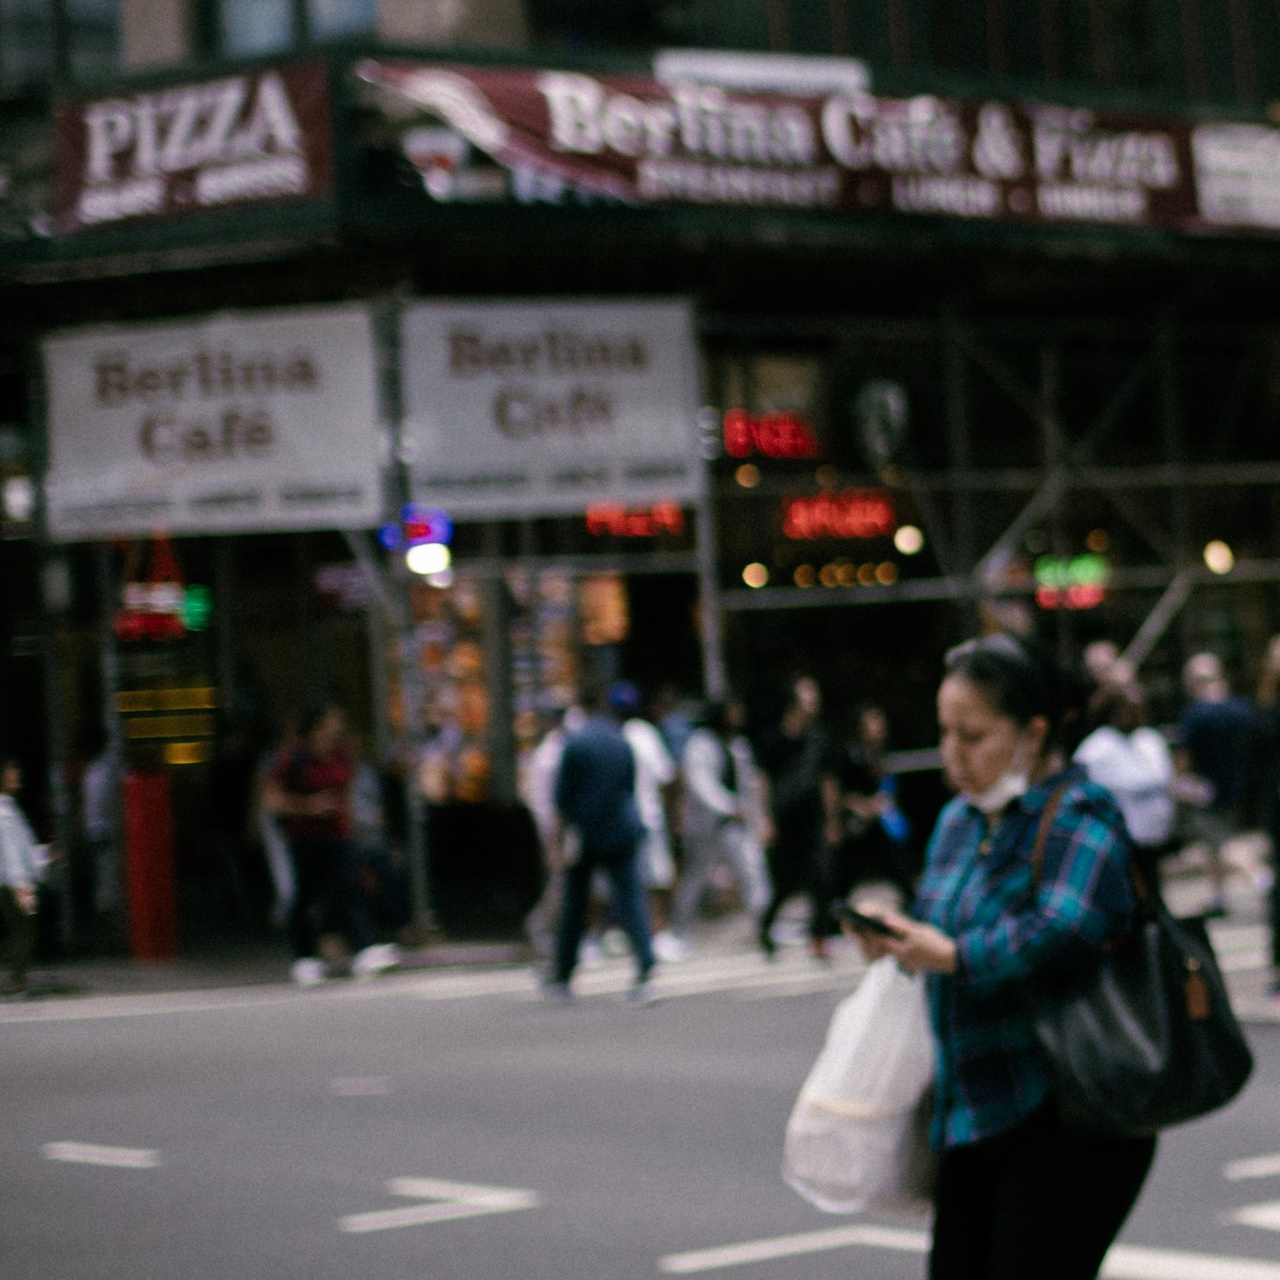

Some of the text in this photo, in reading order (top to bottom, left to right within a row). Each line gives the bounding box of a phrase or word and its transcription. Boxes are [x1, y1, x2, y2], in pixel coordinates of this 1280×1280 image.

[86, 70, 300, 182] PIZZA
[536, 69, 815, 166] Berlina
[974, 104, 1024, 178] &
[94, 350, 317, 408] Berlina
[446, 328, 648, 377] Berlina
